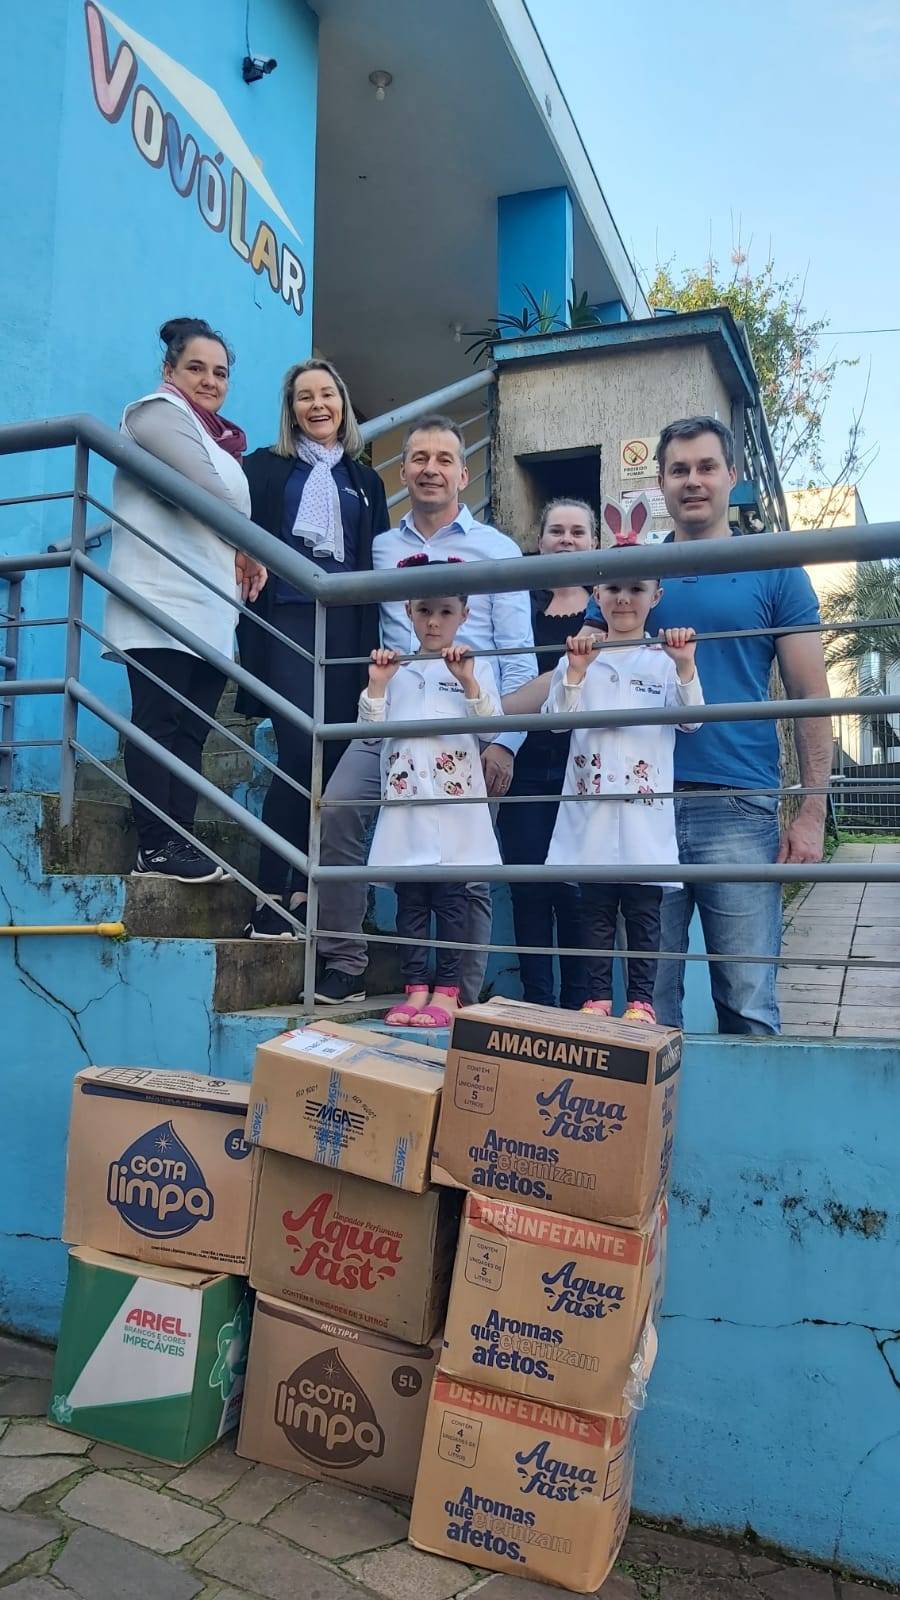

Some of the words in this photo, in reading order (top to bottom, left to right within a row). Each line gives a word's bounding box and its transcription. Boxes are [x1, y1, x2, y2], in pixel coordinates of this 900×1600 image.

[486, 1030, 610, 1071] AMACIANTE
[472, 1091, 478, 1100] 5
[474, 1074, 480, 1083] 4
[316, 1104, 352, 1127] MGA
[536, 1078, 628, 1124] Aqua
[542, 1110, 609, 1142] fast
[231, 1137, 248, 1152] 5L
[484, 1129, 560, 1164] Aromas
[130, 1155, 187, 1181] GOTA
[468, 1145, 498, 1164] que
[496, 1152, 597, 1190] eternizam
[471, 1165, 553, 1201] afetos.
[109, 1164, 211, 1221] limpa
[282, 1193, 403, 1263] Aqua
[365, 1221, 403, 1239] Perfumado
[480, 1206, 626, 1257] DESINFETANTE
[290, 1240, 377, 1291] fast
[481, 1267, 487, 1276] 5
[541, 1261, 626, 1301] Aqua
[315, 1298, 348, 1315] UNIDADES
[364, 1313, 389, 1328] LITROS
[546, 1290, 609, 1319] fast
[124, 1325, 156, 1338] BRANCOS
[162, 1334, 186, 1345] CORES
[125, 1308, 188, 1338] ARIEL
[320, 1322, 359, 1340] MÚLTIPLA
[485, 1309, 563, 1344] Aromas
[123, 1334, 185, 1357] IMPECÁVEIS
[470, 1323, 500, 1342] que
[499, 1333, 600, 1372] eternizam
[471, 1344, 555, 1381] afetos.
[299, 1379, 357, 1413] GOTA
[398, 1379, 417, 1390] 5L
[276, 1383, 380, 1453] limpa
[448, 1382, 591, 1436] DESINFETANTE
[455, 1444, 461, 1452] 5
[457, 1429, 463, 1437] 4
[515, 1441, 598, 1484] Aqua
[520, 1472, 581, 1501] fast
[459, 1486, 536, 1527] Aromas
[444, 1500, 474, 1520] que
[472, 1511, 574, 1554] eternizam
[446, 1520, 527, 1563] afetos.
